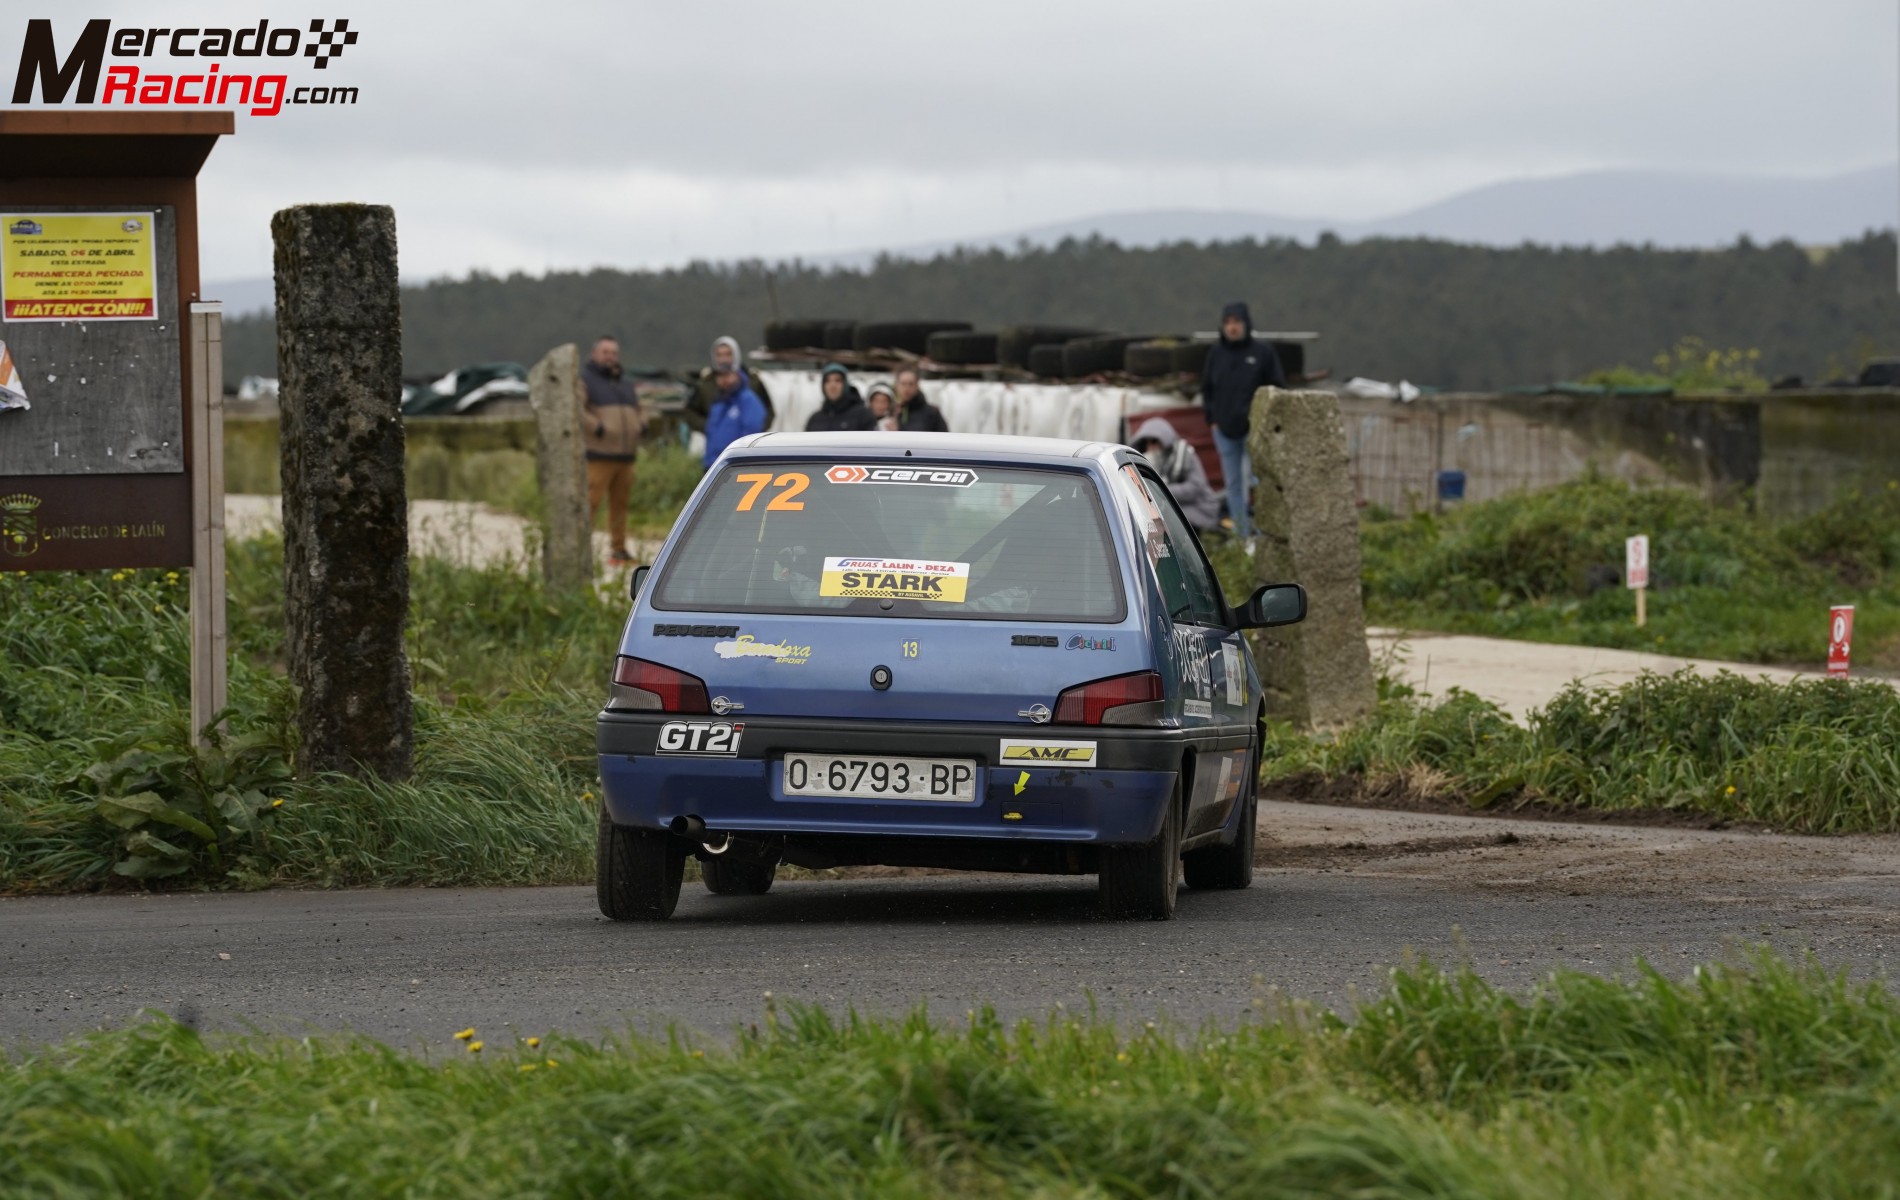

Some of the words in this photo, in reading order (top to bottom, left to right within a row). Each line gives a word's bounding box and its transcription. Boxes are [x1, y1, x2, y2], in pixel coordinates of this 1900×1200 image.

[736, 473, 810, 511] 72
[42, 526, 109, 540] CONCELLO
[113, 525, 129, 538] DE
[132, 521, 166, 537] LALÍN
[837, 558, 883, 569] GRUAS
[882, 562, 914, 570] LALIN
[925, 565, 956, 573] DEZA
[841, 572, 943, 593] STARK
[653, 624, 740, 638] PEUGEOT
[1010, 634, 1059, 647] 106
[902, 641, 918, 658] 13
[775, 656, 808, 664] SPORT
[656, 722, 744, 753] GT2i
